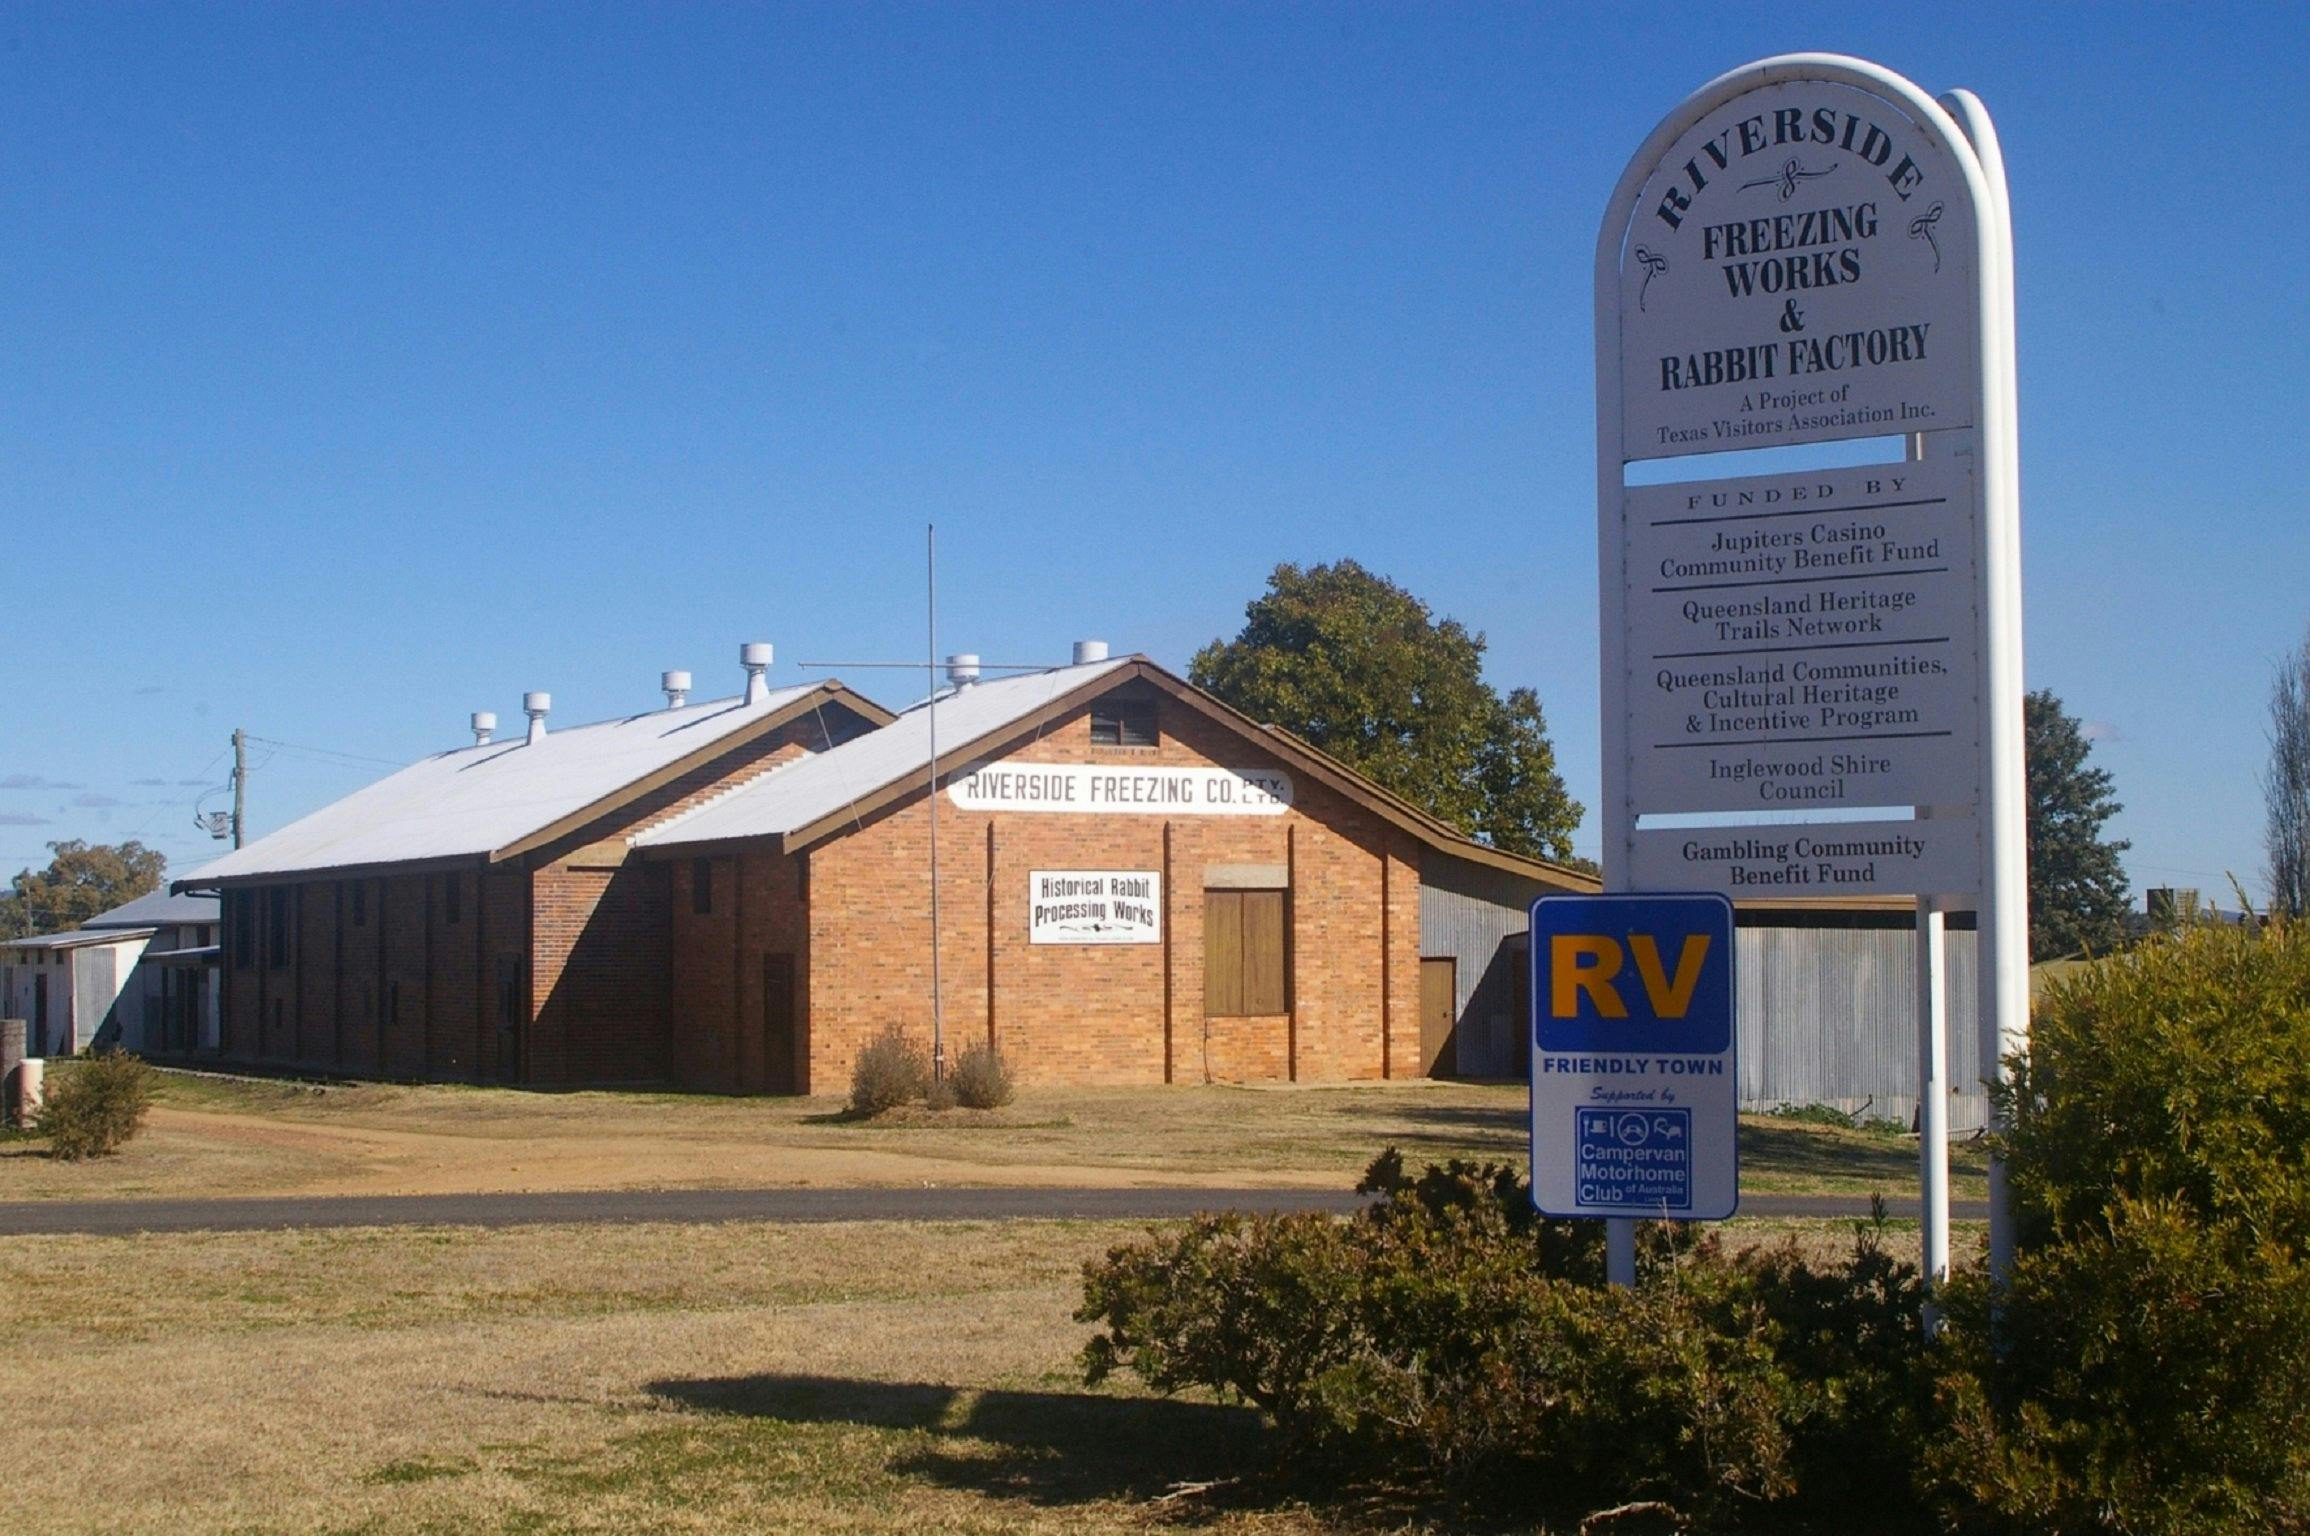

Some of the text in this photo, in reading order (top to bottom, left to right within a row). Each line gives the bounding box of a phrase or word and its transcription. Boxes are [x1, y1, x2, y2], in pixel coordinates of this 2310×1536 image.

[1655, 107, 1924, 233] RIVERSIDE
[1702, 202, 1878, 260] FREEZING
[1722, 247, 1861, 298] WORKS
[1779, 298, 1805, 333] &
[1660, 323, 1931, 392] RABBIT FACTORY
[1740, 385, 1849, 413] A Project of
[1657, 401, 1935, 444] Texas Visitors Association Inc.
[1687, 478, 1907, 510] FUNDED BY
[1711, 522, 1886, 553] Jupiters Casino
[1660, 539, 1939, 579] Community Benefit Fund
[1682, 590, 1916, 623] Queensland Heritage
[1715, 613, 1883, 641] Trails Network
[1656, 655, 1948, 692] Queensland Communities,
[1703, 682, 1900, 710] Cultural Heritage
[1685, 707, 1919, 734] & Incentive Program
[1710, 754, 1891, 782] Inglewood Shire
[967, 771, 1237, 804] RIVERSIDE FREEZING CO.
[1243, 779, 1284, 791] PTY.
[1759, 779, 1844, 801] Council
[1682, 834, 1926, 863] Gambling Community
[1041, 877, 1150, 898] Historical Rabbit
[1730, 862, 1875, 886] Benefit Fund
[1035, 901, 1153, 928] Processing Works
[1550, 933, 1711, 1019] RV
[1543, 1058, 1723, 1075] FRIENDLY TOWN
[1590, 1086, 1675, 1104] Supported by
[1581, 1144, 1685, 1164] Campervan
[1581, 1163, 1685, 1181] Motorhome
[1581, 1184, 1623, 1201] Club
[1625, 1184, 1684, 1194] of Australia
